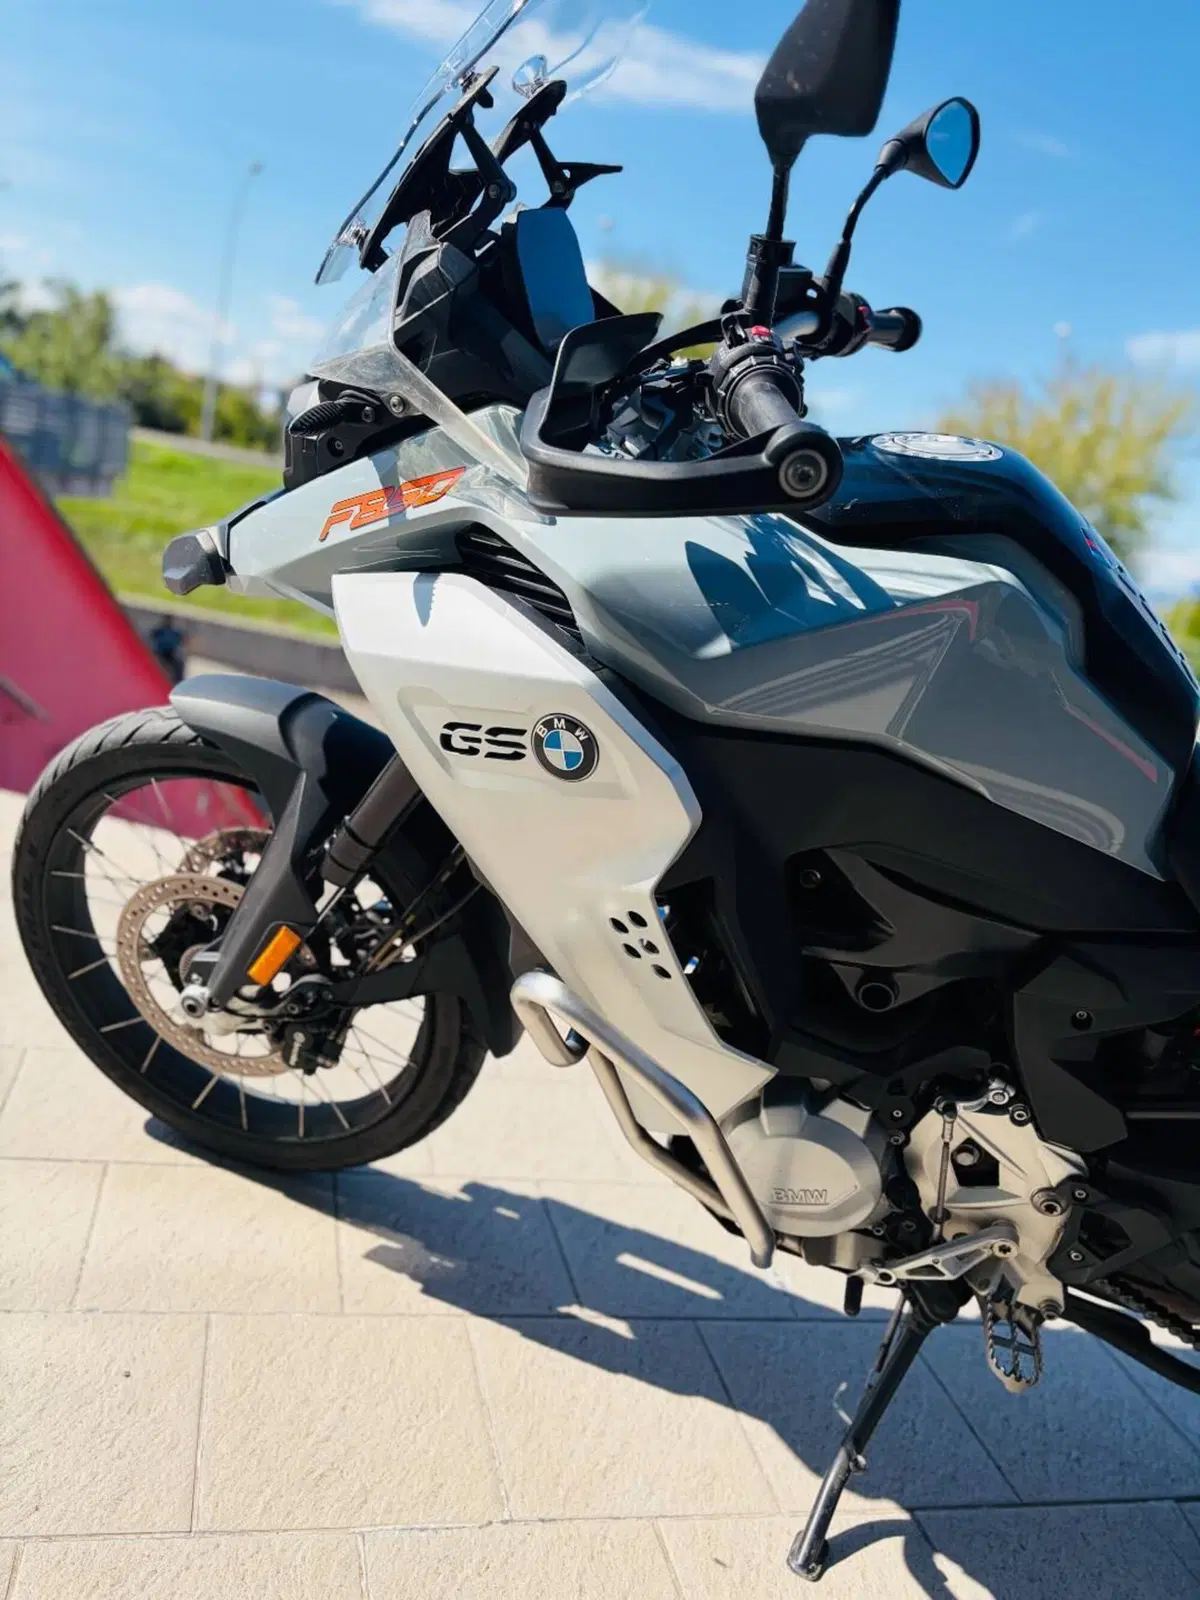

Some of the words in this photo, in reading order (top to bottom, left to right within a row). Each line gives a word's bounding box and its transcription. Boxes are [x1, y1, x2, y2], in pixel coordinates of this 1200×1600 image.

[439, 721, 528, 761] GS
[536, 718, 589, 741] BMW
[771, 1187, 828, 1205] BMW
